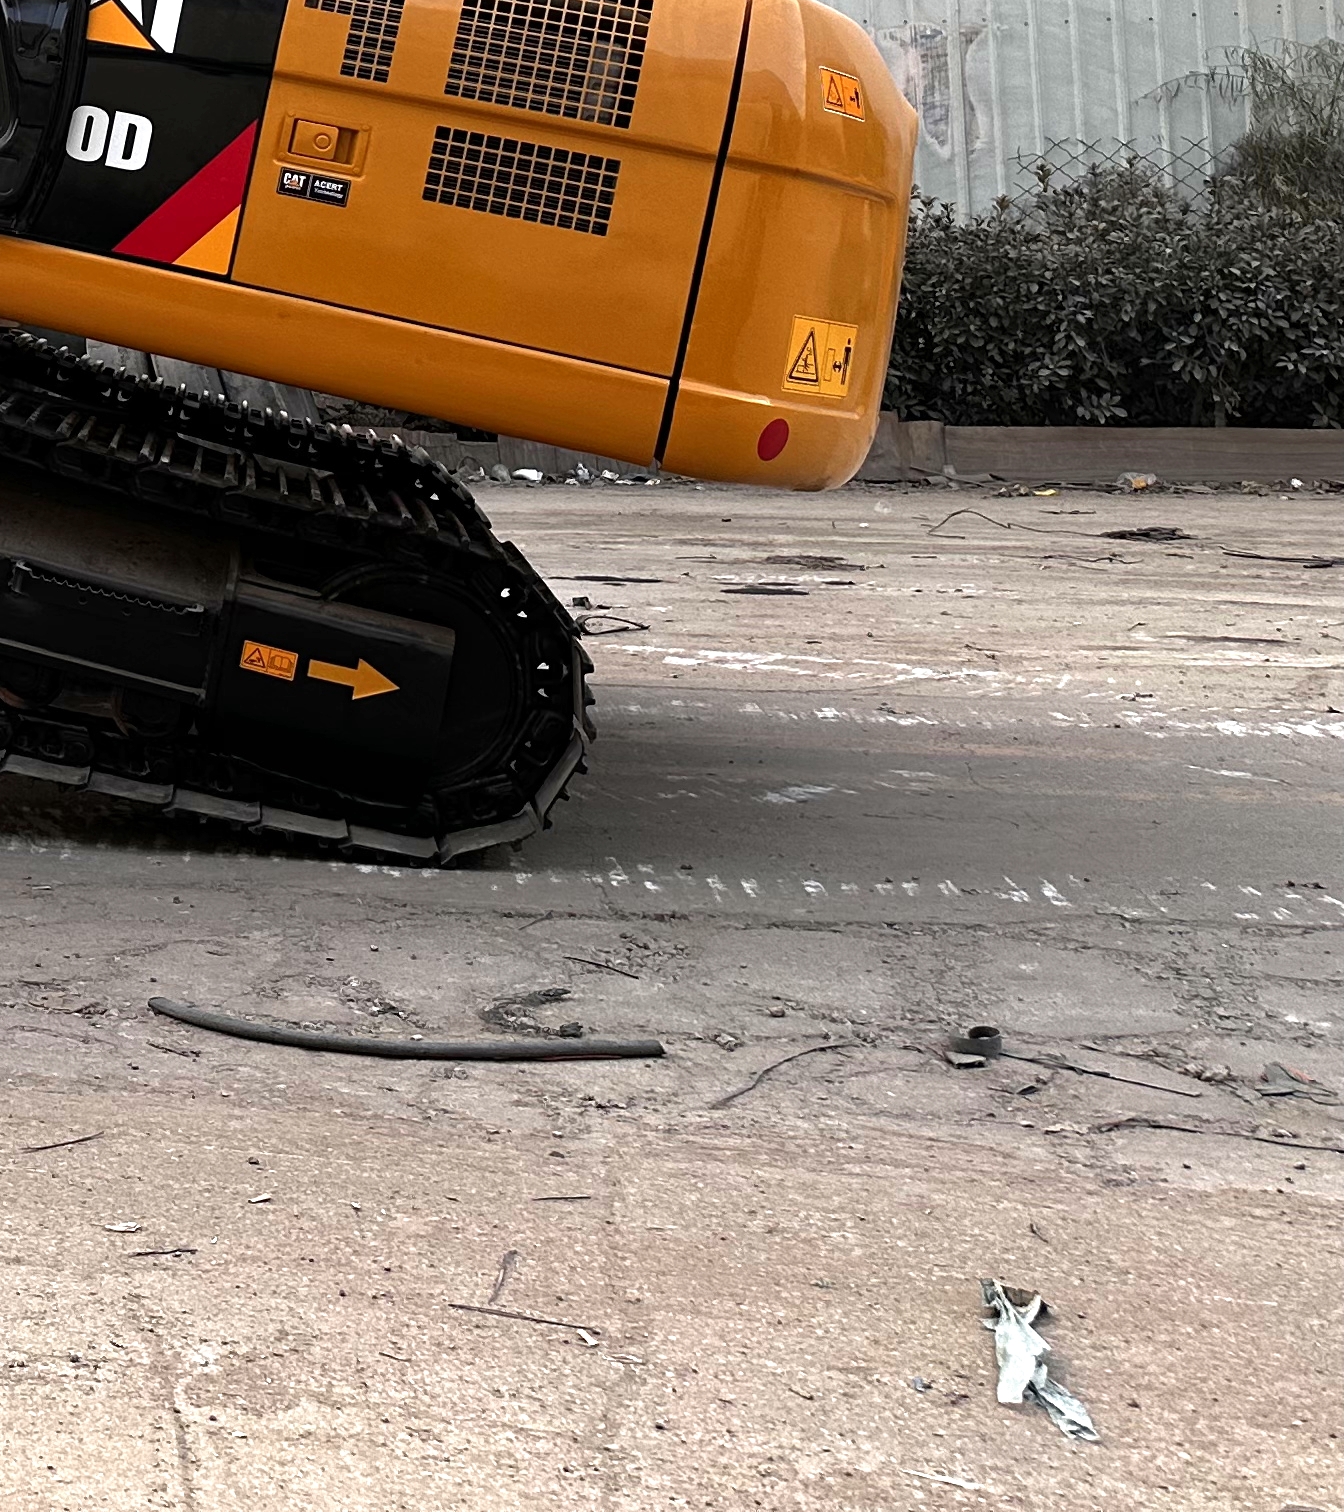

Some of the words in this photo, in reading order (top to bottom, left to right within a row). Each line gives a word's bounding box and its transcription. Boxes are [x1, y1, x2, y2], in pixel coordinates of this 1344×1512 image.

[66, 105, 153, 170] 0D
[283, 172, 307, 187] CAT
[314, 180, 343, 191] ACERT
